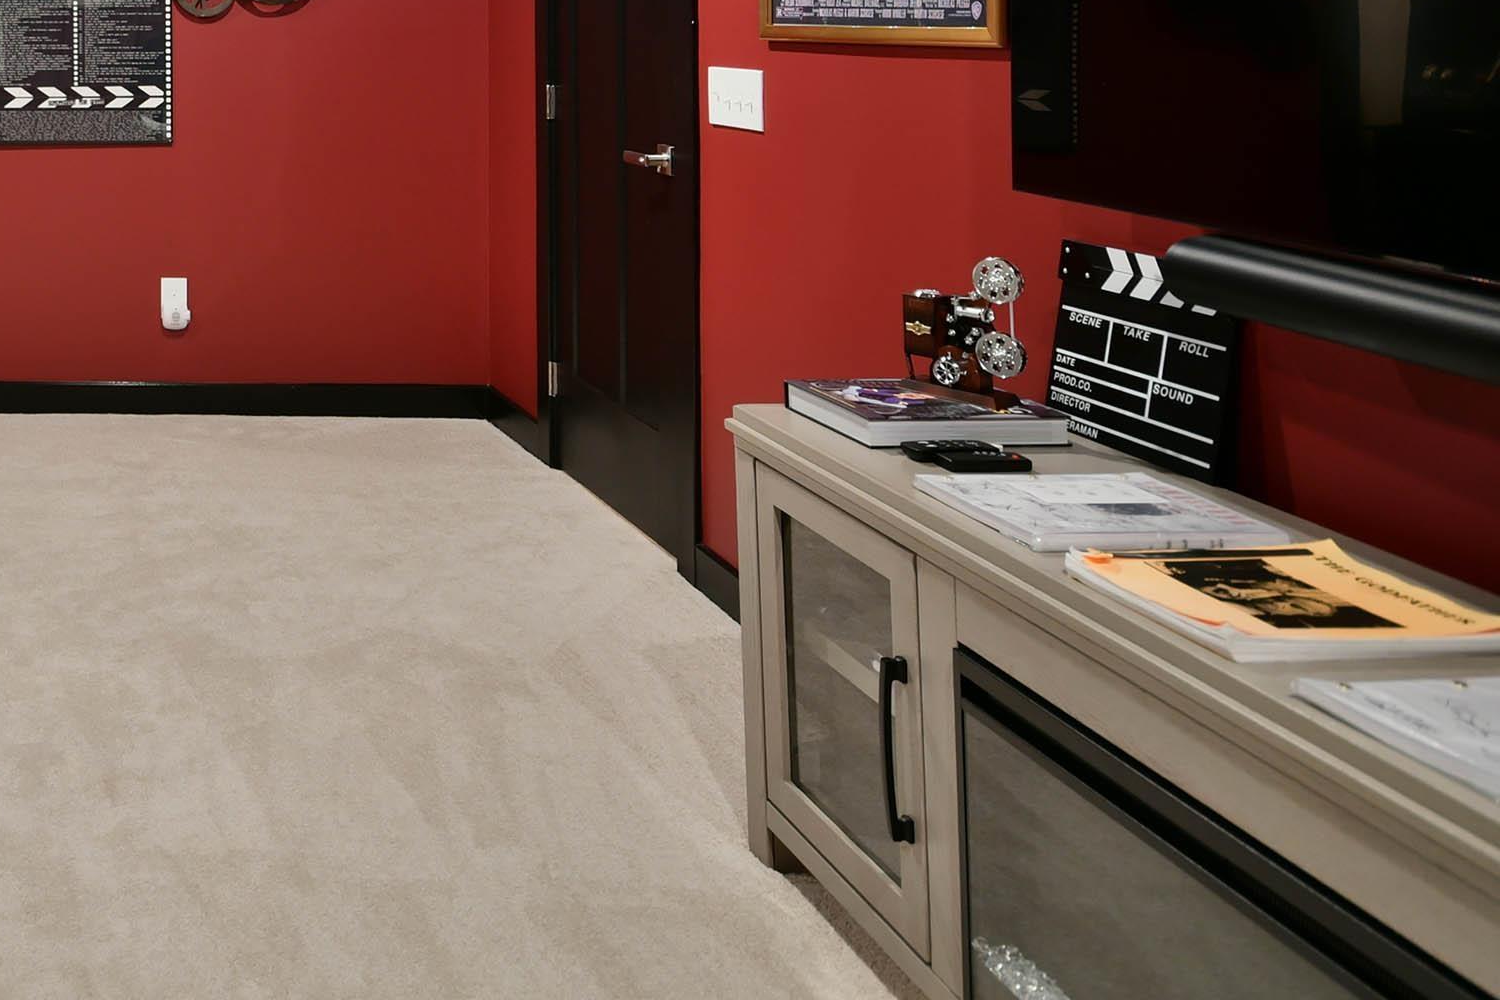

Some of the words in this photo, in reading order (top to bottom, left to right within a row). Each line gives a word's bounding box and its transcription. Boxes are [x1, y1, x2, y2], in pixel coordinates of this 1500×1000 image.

[1069, 311, 1102, 329] SCENE
[1123, 325, 1151, 342] TAKE
[1178, 341, 1209, 358] ROLL
[1055, 354, 1076, 367] DATE
[1051, 391, 1091, 413] DIRECTOR
[1152, 384, 1194, 405] SOUND
[1066, 419, 1099, 439] ERAMAN
